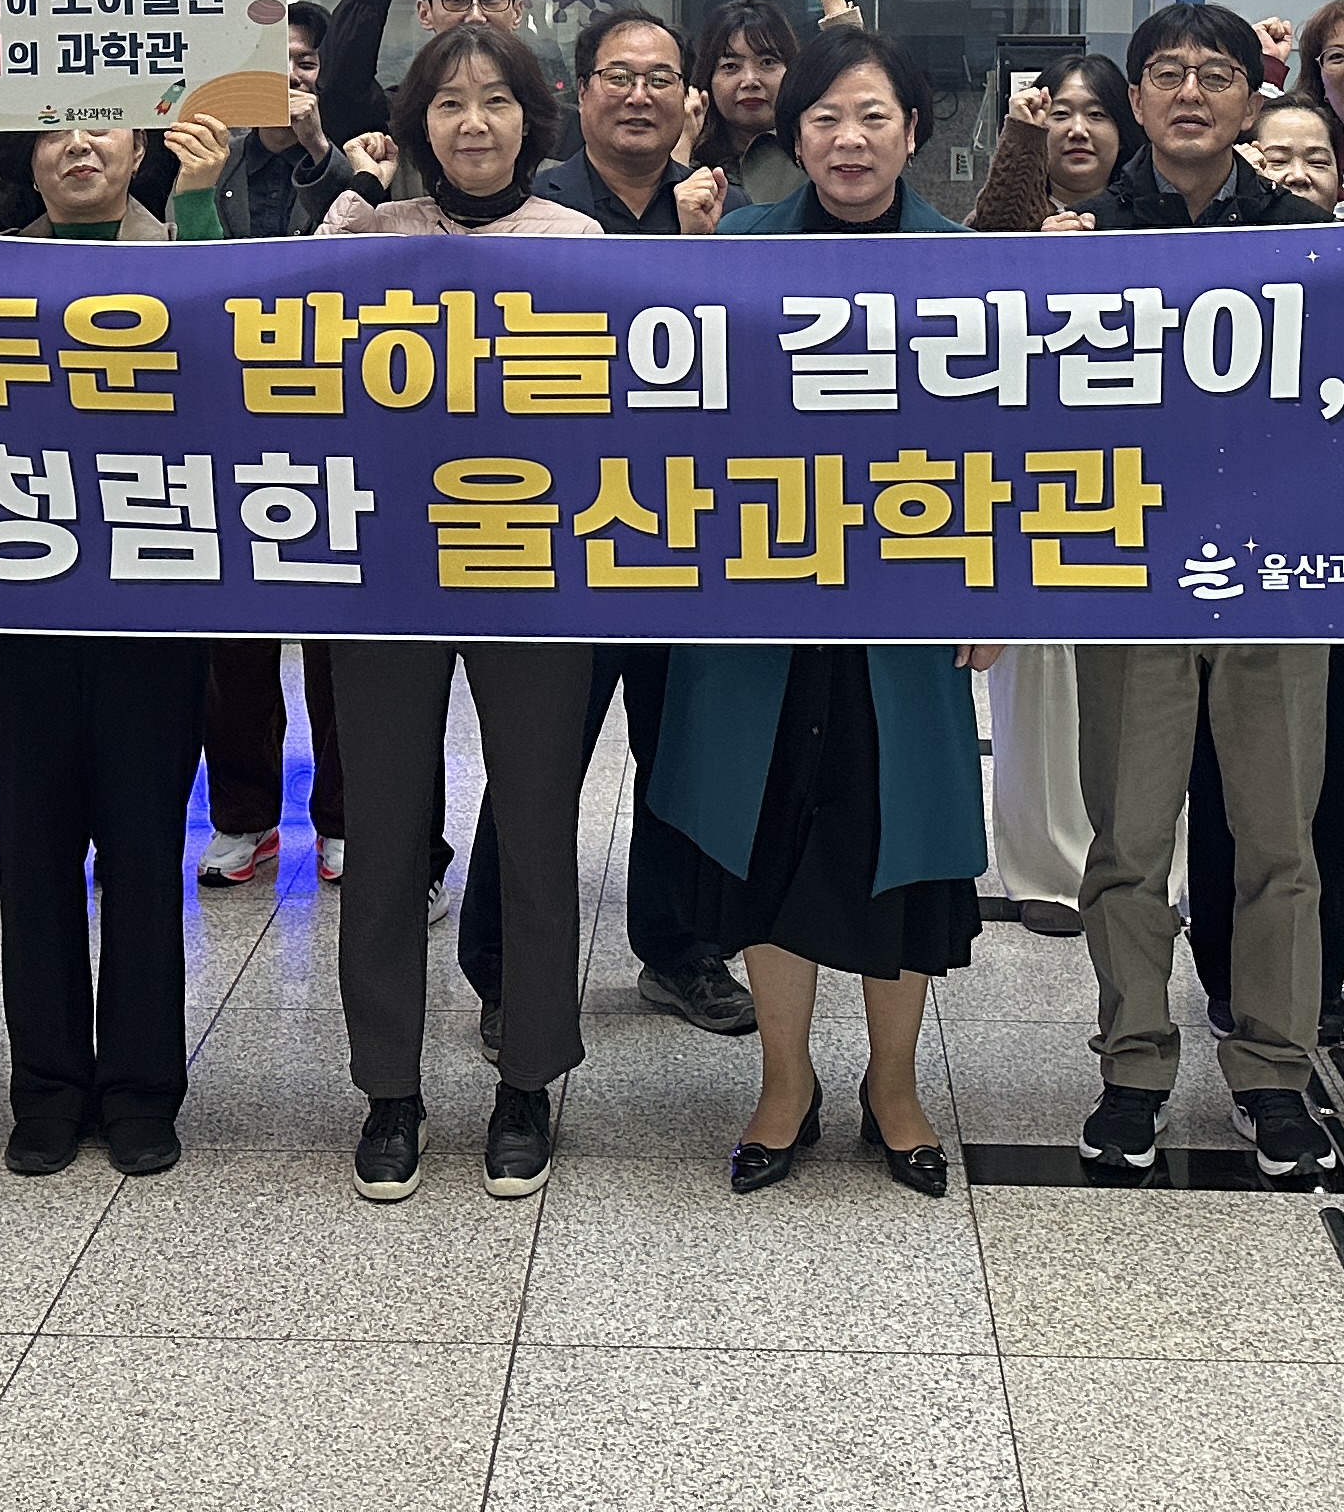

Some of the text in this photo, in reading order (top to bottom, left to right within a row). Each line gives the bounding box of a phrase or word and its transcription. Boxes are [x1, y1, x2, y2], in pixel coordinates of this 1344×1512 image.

[56, 31, 189, 76] 과학관
[64, 108, 124, 121] 울산과학관
[223, 287, 730, 416] 밤하늘의
[426, 446, 1164, 591] 울산과학관
